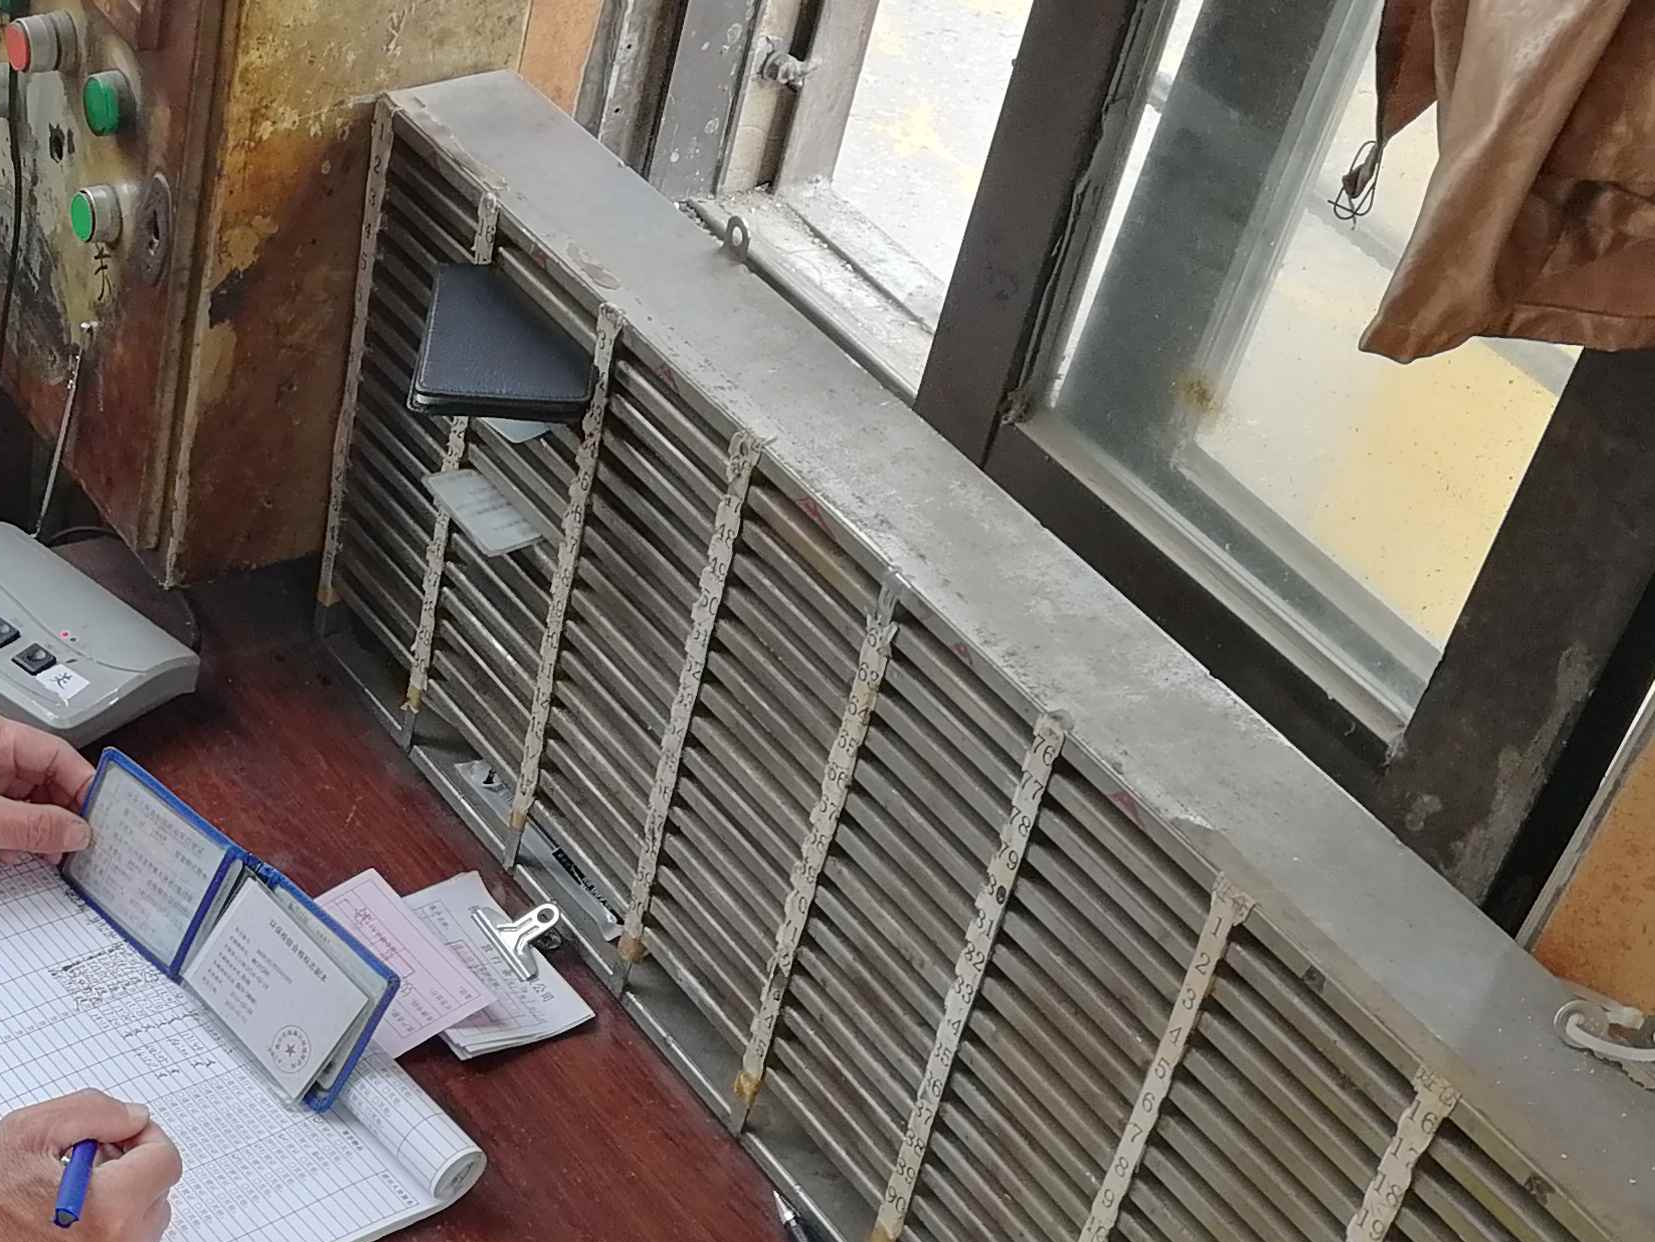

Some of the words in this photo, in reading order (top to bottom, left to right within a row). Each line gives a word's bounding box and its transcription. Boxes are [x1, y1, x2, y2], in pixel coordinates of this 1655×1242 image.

[1033, 734, 1053, 766] 76
[1020, 771, 1044, 801] 77
[1008, 807, 1031, 837] 78
[997, 841, 1019, 871] 79
[1211, 917, 1223, 937] 1
[1194, 951, 1211, 976] 2
[1182, 987, 1196, 1010] 3
[1169, 1026, 1183, 1045] 4
[1154, 1056, 1171, 1080] 5
[1142, 1091, 1156, 1113] 6
[1407, 1099, 1439, 1135] 16
[1129, 1122, 1143, 1143] 7
[1114, 1155, 1129, 1178] 8
[1102, 1188, 1114, 1208] 9
[1373, 1170, 1403, 1206] 18
[1356, 1209, 1386, 1242] 19
